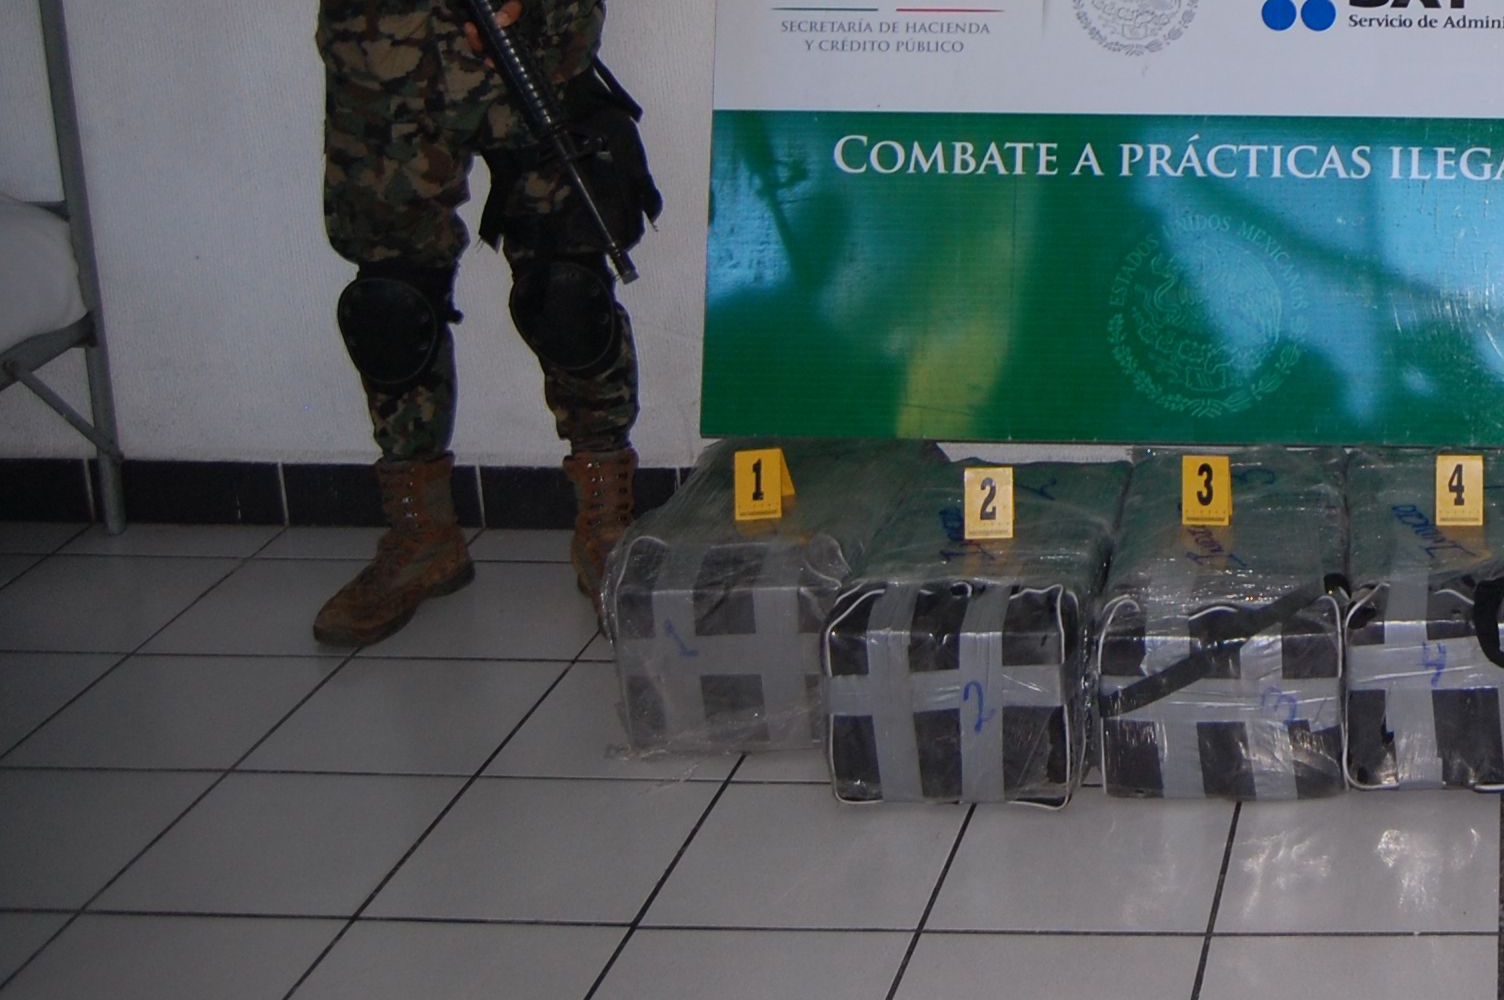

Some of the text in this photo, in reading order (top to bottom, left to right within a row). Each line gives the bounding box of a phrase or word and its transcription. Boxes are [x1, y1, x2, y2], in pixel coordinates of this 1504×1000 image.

[781, 18, 990, 35] SECRETARÍA DE HACIENDA
[1349, 13, 1413, 28] Servicio
[1417, 14, 1438, 28] de
[804, 38, 965, 53] Y CRÉDITO PÚBLICO
[833, 135, 1059, 175] COMBATE
[1071, 142, 1104, 176] A
[1118, 134, 1372, 180] PRÁCTICAS
[752, 458, 764, 501] 1
[980, 477, 997, 521] 2
[1196, 463, 1214, 506] 3
[1448, 463, 1465, 506] 4
